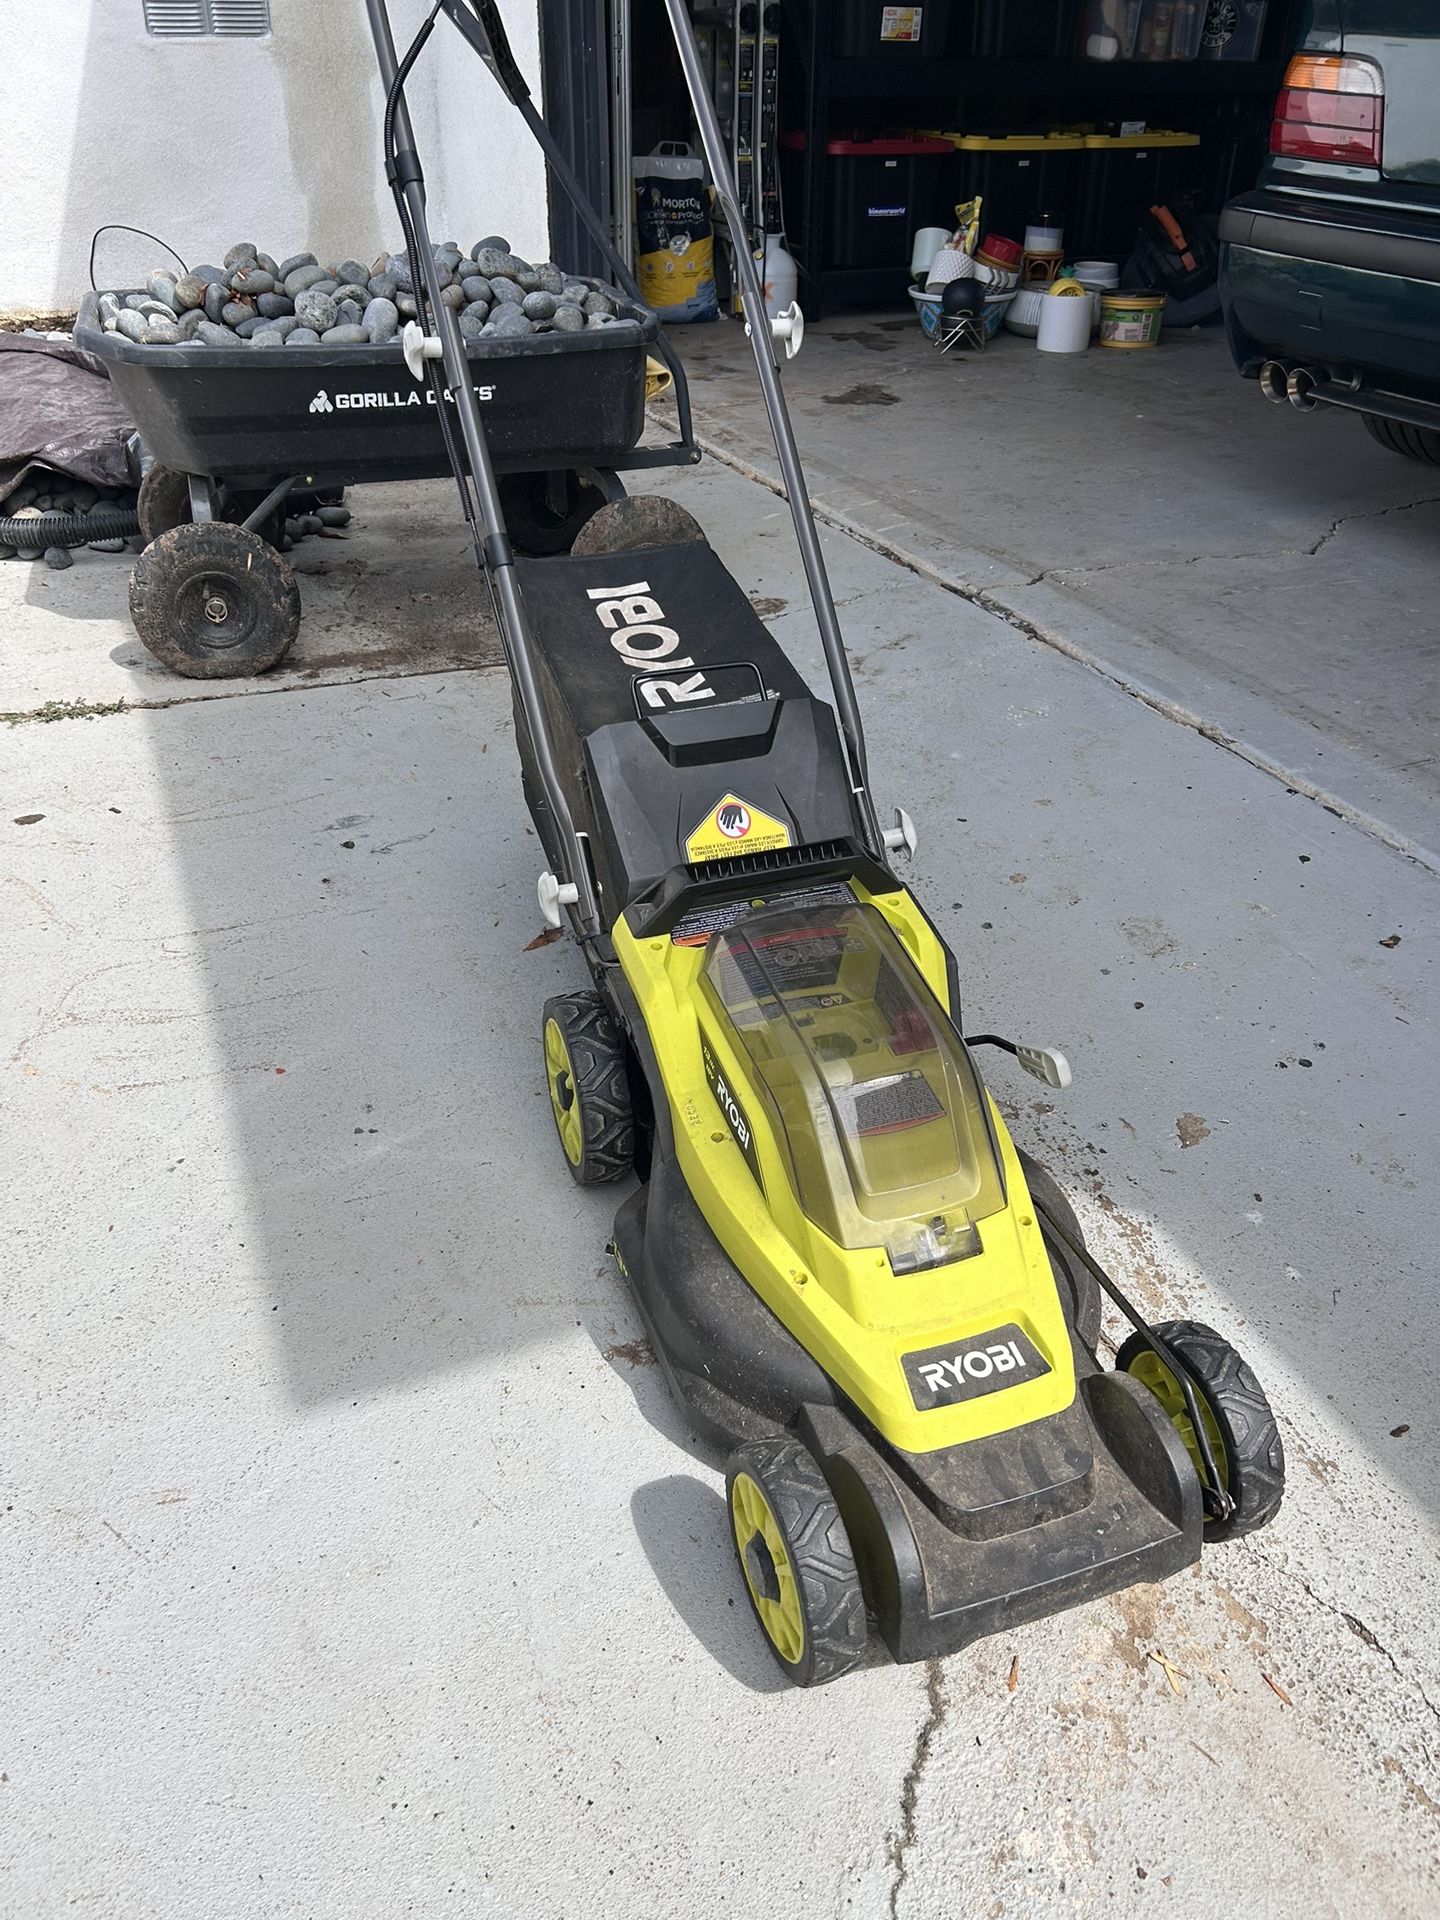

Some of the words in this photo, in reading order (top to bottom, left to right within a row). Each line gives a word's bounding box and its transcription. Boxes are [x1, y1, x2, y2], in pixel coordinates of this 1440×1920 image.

[335, 391, 421, 409] GORILLA
[426, 386, 493, 405] CAS
[586, 581, 716, 708] RYOBI
[717, 1074, 750, 1150] RYOBI
[918, 1341, 1027, 1393] RYOBI
